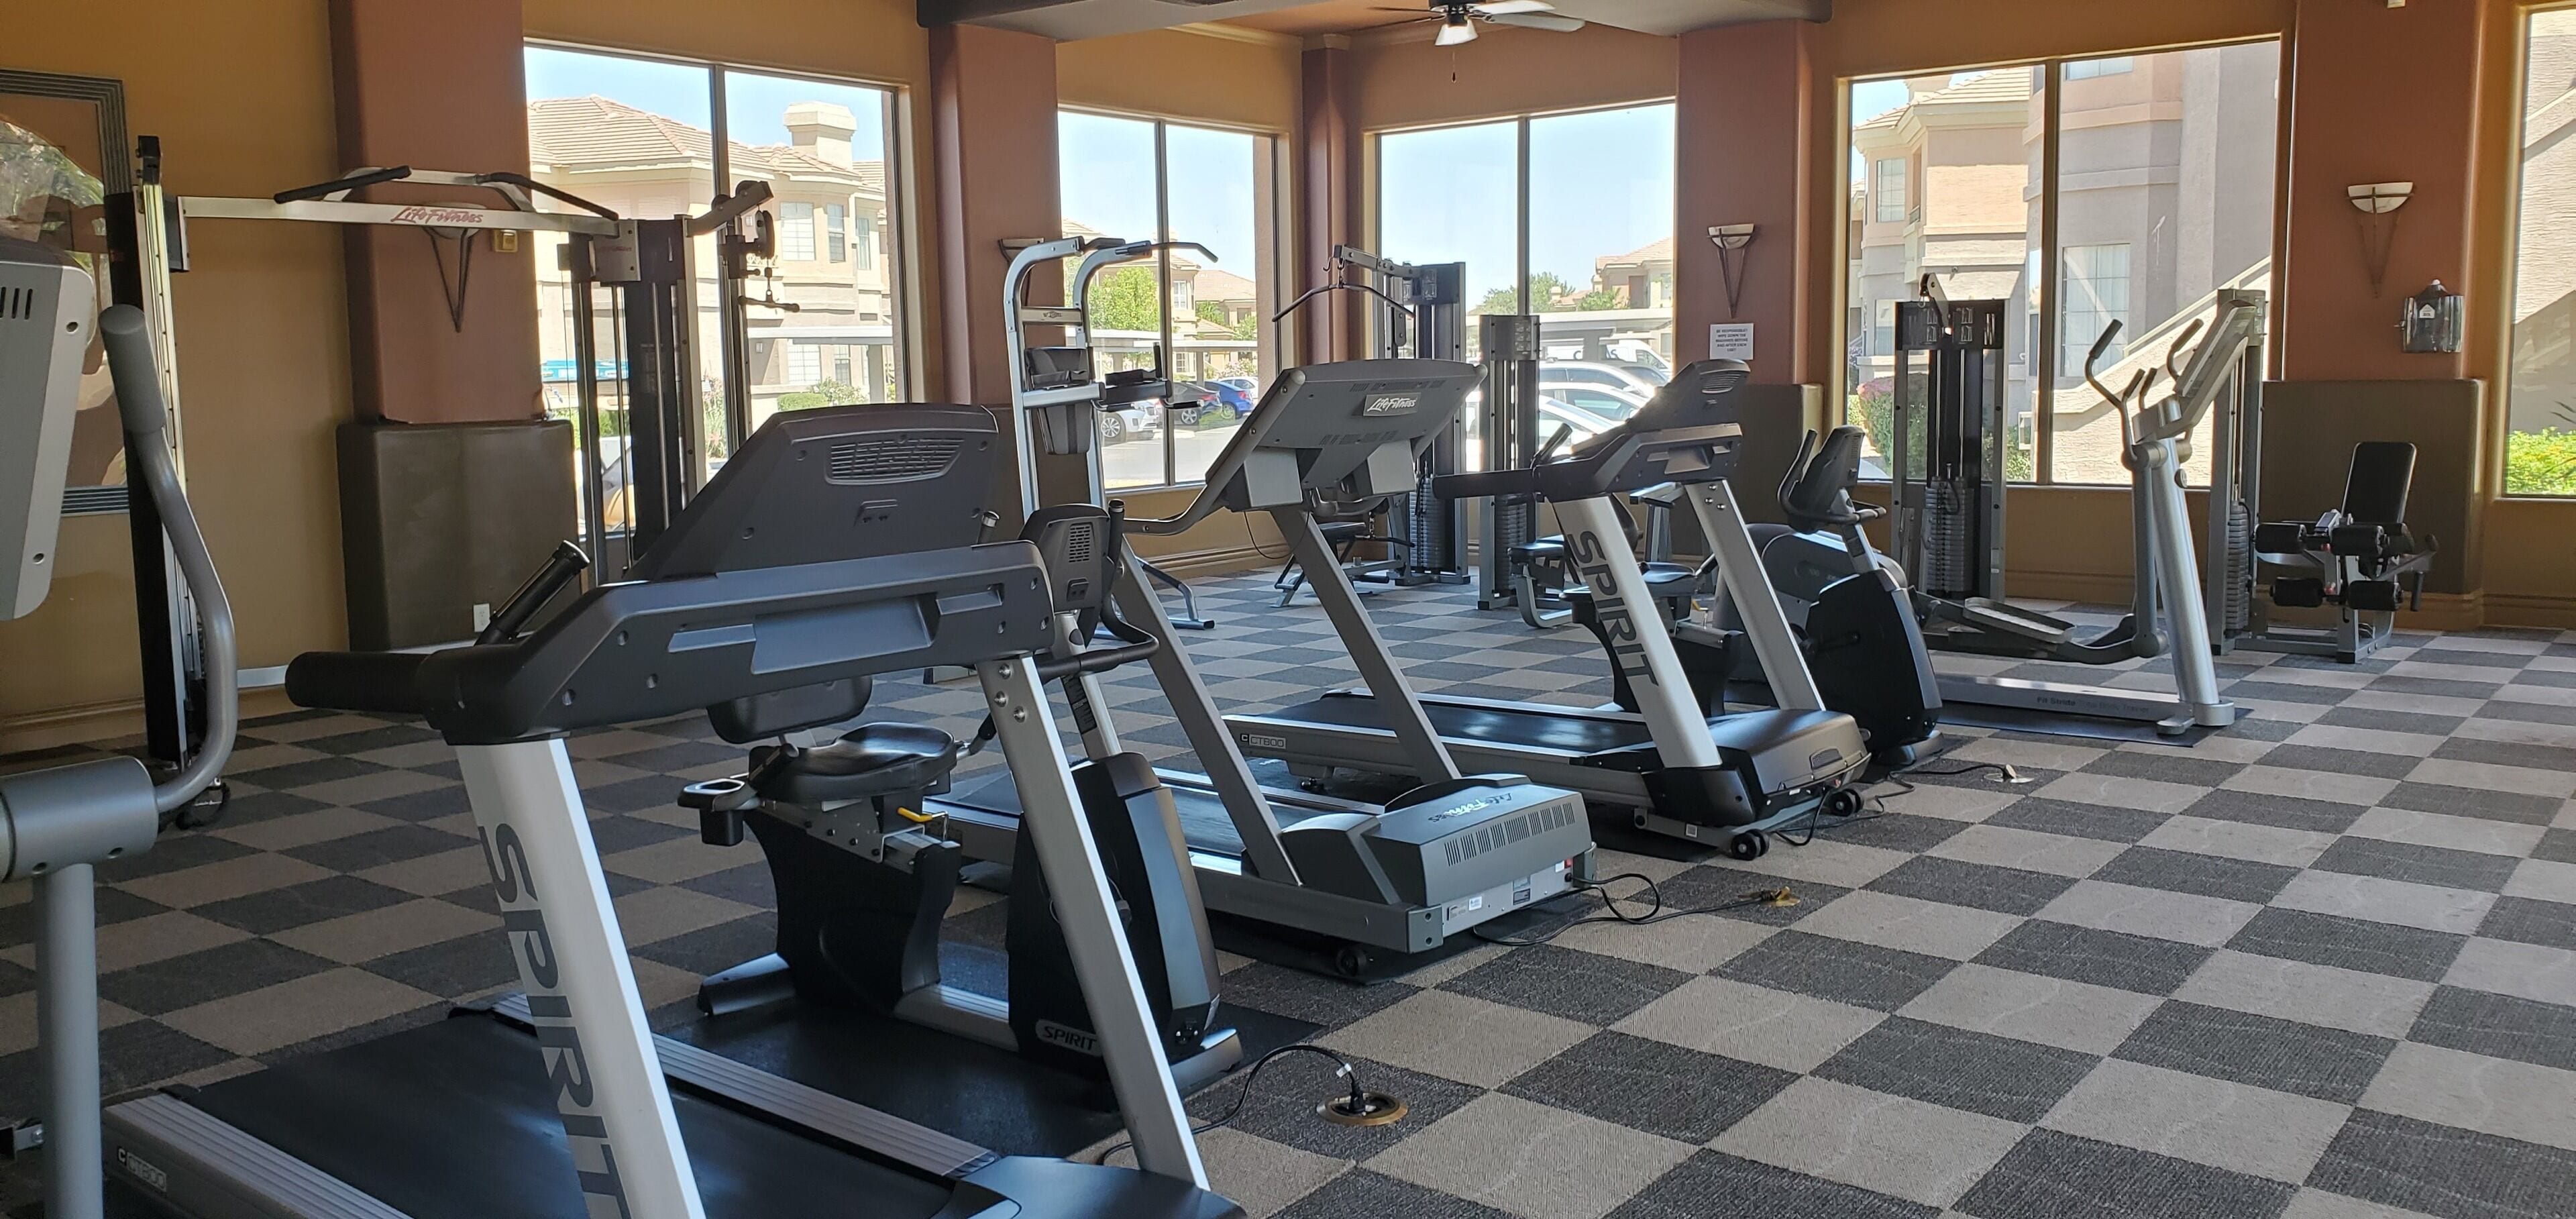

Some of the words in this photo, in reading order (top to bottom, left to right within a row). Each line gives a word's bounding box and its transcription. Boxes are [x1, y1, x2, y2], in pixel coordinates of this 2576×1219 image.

[1567, 531, 1659, 686] SPIRIT
[2050, 697, 2076, 706] Stride
[1250, 736, 1284, 747] CT800
[478, 823, 632, 1219] SPIRIT
[1044, 1026, 1097, 1051] SPIRIT
